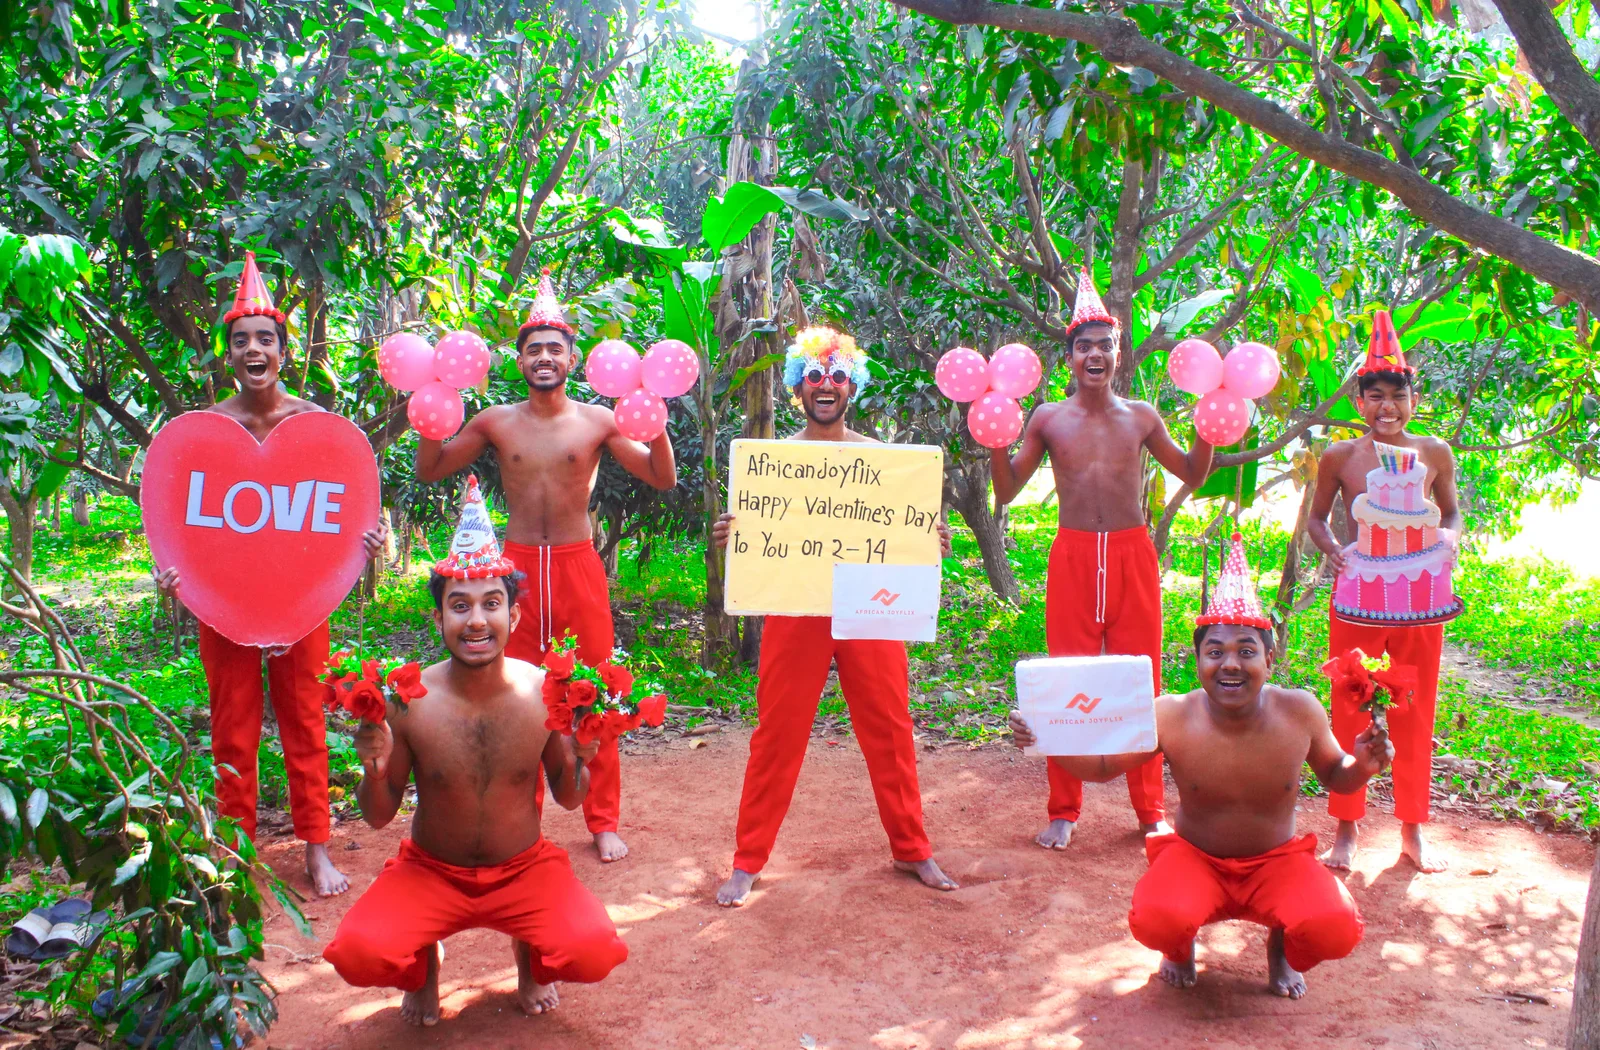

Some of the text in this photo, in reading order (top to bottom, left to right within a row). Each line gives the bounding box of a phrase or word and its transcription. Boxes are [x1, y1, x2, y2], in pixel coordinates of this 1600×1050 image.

[184, 469, 346, 535] LOVE
[738, 489, 939, 534] Happy Valentine's Day
[733, 530, 749, 554] to
[761, 530, 789, 559] You
[801, 538, 823, 558] on
[1089, 716, 1124, 724] JOYFLIX
